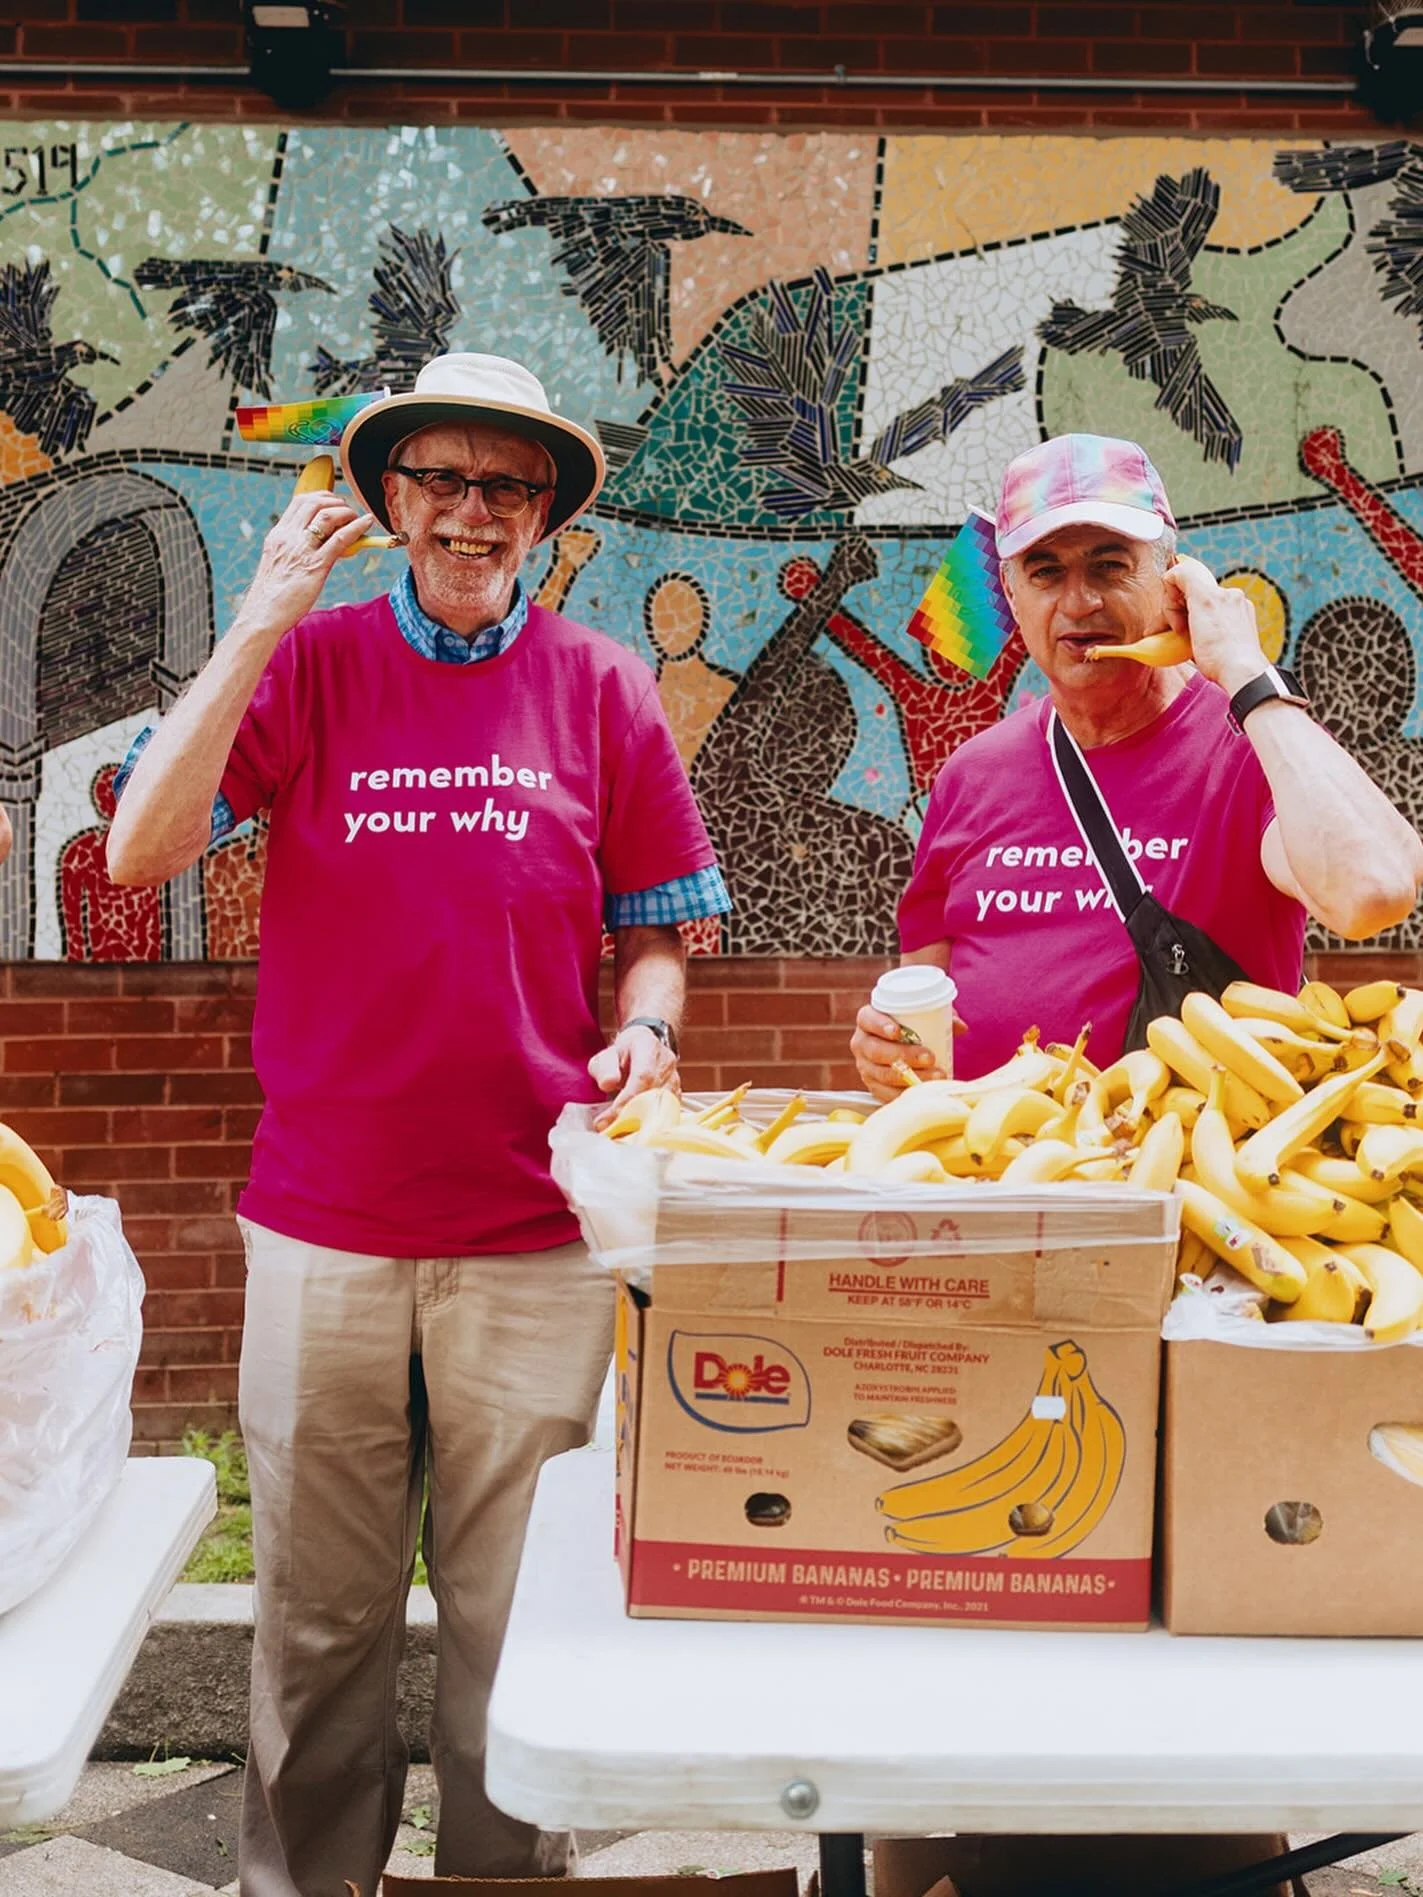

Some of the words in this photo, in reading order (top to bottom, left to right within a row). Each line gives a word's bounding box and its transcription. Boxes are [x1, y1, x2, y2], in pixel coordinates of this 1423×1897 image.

[2, 142, 78, 196] 519
[349, 753, 553, 792] remember
[343, 809, 437, 843] your
[449, 797, 530, 842] why
[985, 827, 1189, 868] remeber
[975, 889, 1063, 922] your
[829, 1273, 896, 1290] HANDLE
[900, 1276, 940, 1292] WITH
[944, 1279, 990, 1294] CARE
[848, 1295, 878, 1305] KEEP
[881, 1297, 897, 1307] AT
[925, 1298, 944, 1309] OR
[823, 1347, 853, 1358] DOLE
[856, 1348, 893, 1359] FRESH
[894, 1350, 927, 1362] FRUIT
[929, 1352, 990, 1364] COMPANY
[844, 1337, 896, 1348] Distributed
[693, 1351, 791, 1397] Dole
[854, 1361, 914, 1373] CHARLOTTE,
[915, 1364, 930, 1374] NC
[854, 1392, 866, 1402] TO
[687, 1559, 786, 1584] PREMIUM
[792, 1564, 890, 1588] BANANAS
[907, 1569, 1004, 1592] PREMIUM
[1010, 1573, 1105, 1595] BANANAS
[846, 1597, 869, 1608] Dole
[870, 1598, 894, 1609] Food
[964, 1602, 989, 1613] 2021
